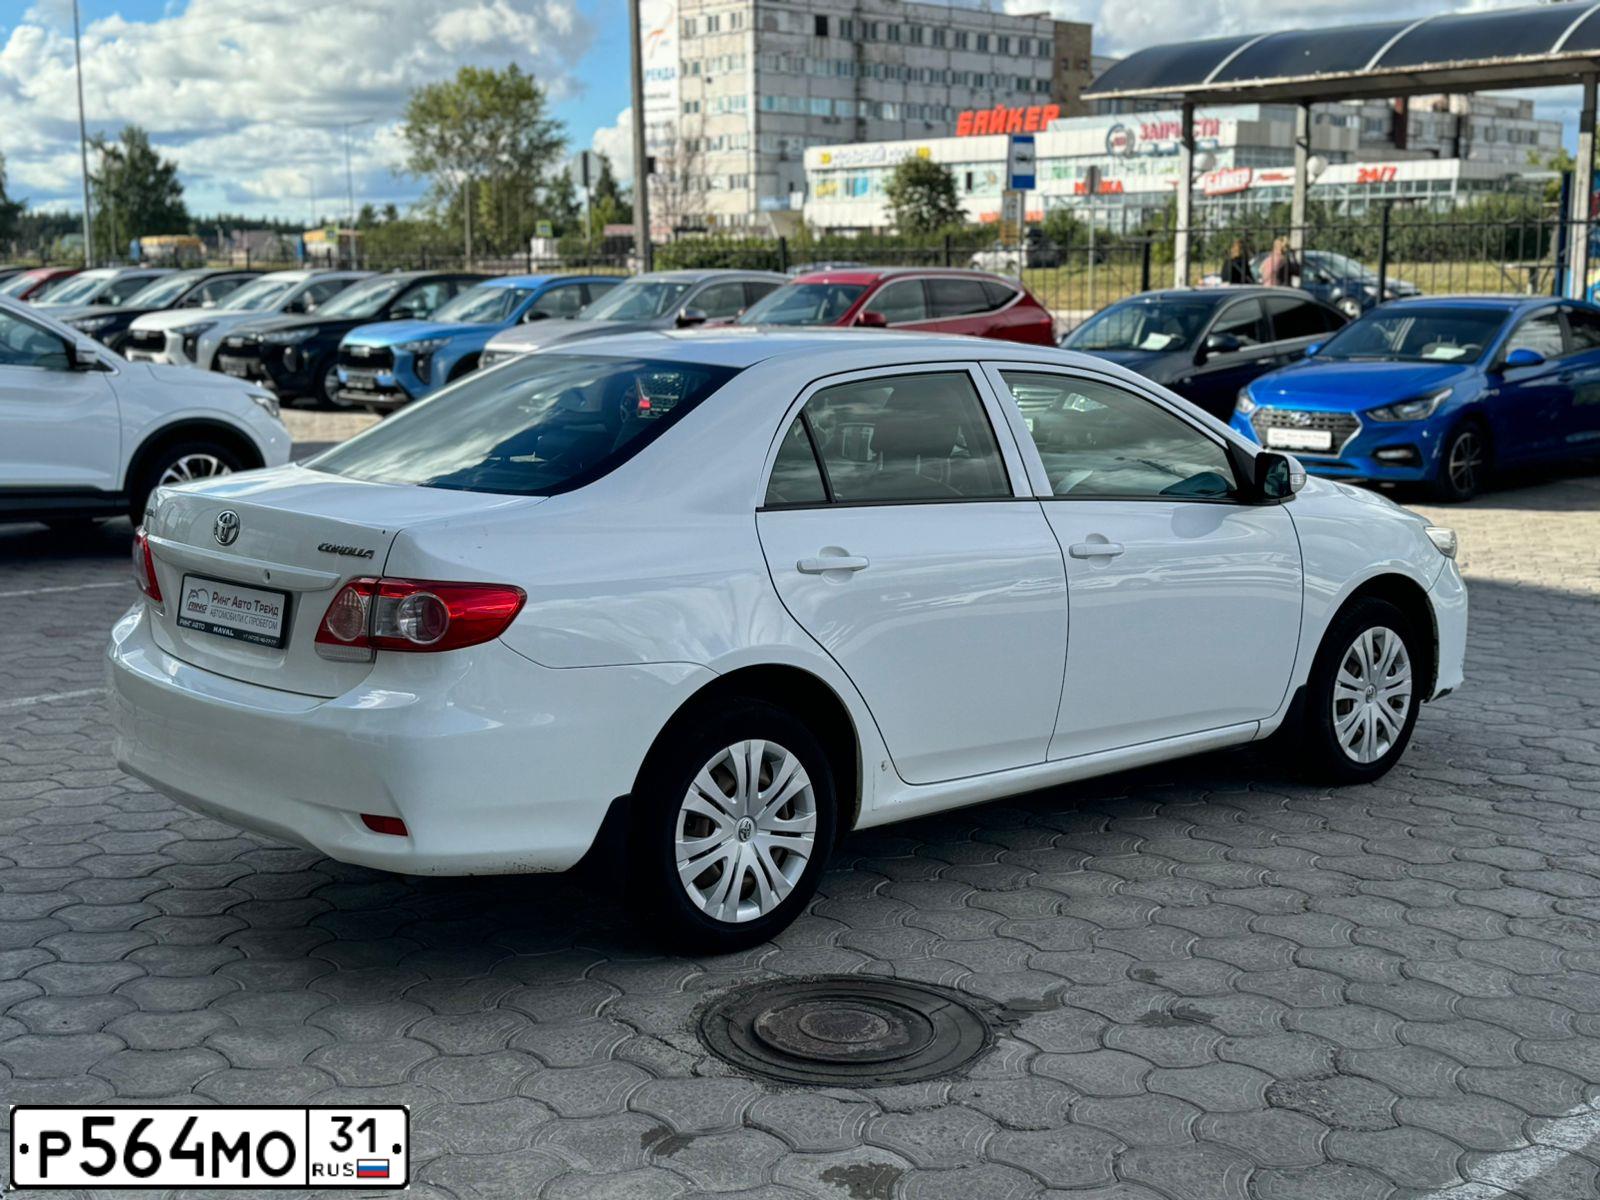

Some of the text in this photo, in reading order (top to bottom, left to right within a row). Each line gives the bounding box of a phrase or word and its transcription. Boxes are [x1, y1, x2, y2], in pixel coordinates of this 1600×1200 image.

[956, 103, 1060, 137] БАЙКЕР
[1140, 118, 1220, 141] ЗАПЧСТИ
[1357, 165, 1397, 184] 24/7
[1074, 180, 1124, 196] МКА
[317, 542, 375, 559] COROLLA
[188, 601, 208, 611] RING
[213, 626, 234, 636] HAVAL
